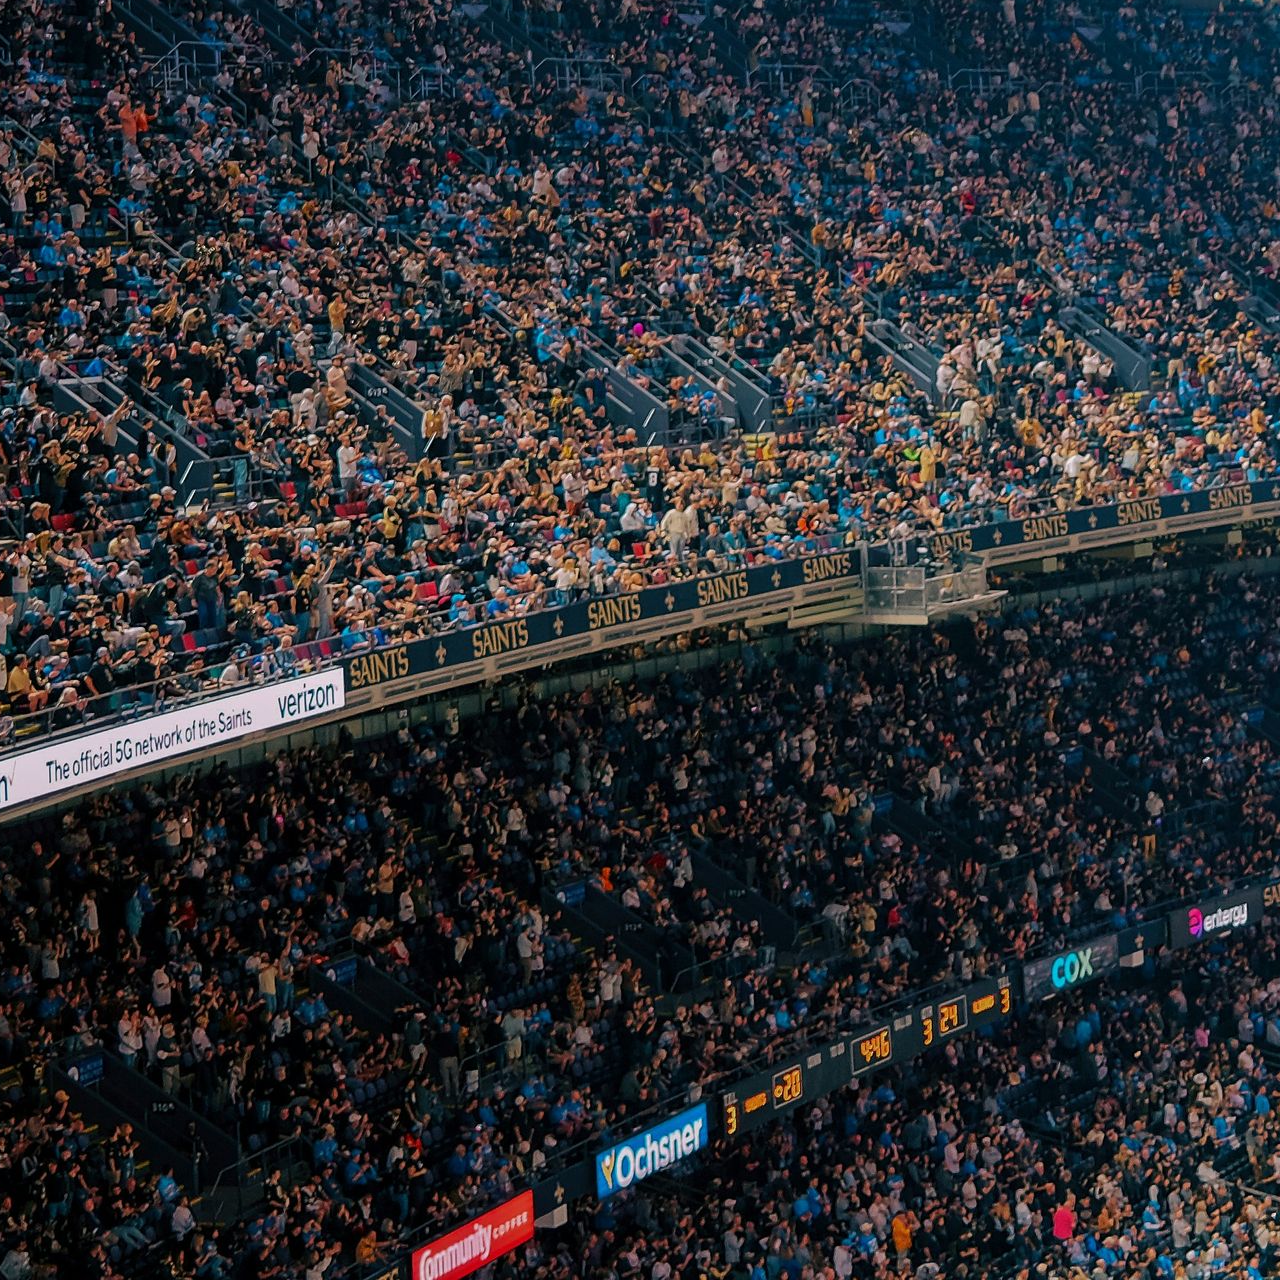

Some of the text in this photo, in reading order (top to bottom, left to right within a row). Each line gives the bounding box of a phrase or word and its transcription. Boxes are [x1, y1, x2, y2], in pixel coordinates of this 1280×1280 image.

[1117, 497, 1162, 526] SAINTS
[1209, 483, 1253, 509] SAINTS
[1023, 514, 1069, 541] SAINTS
[803, 553, 851, 583] SAINTS
[697, 571, 748, 606] SAINTS
[588, 593, 641, 630] SAINTS
[472, 619, 528, 659] SAINTS
[350, 646, 409, 688] SAINTS
[46, 760, 70, 784] The
[72, 746, 114, 776] official
[115, 740, 133, 762] 5G
[135, 724, 183, 756] network
[185, 723, 197, 743] of
[197, 718, 216, 740] the
[218, 708, 253, 734] Saints
[278, 681, 335, 719] verizon
[1204, 902, 1248, 932] entergy
[1051, 947, 1094, 989] COX
[616, 1117, 703, 1188] Ochsner
[420, 1211, 528, 1280] Community COFFEE
